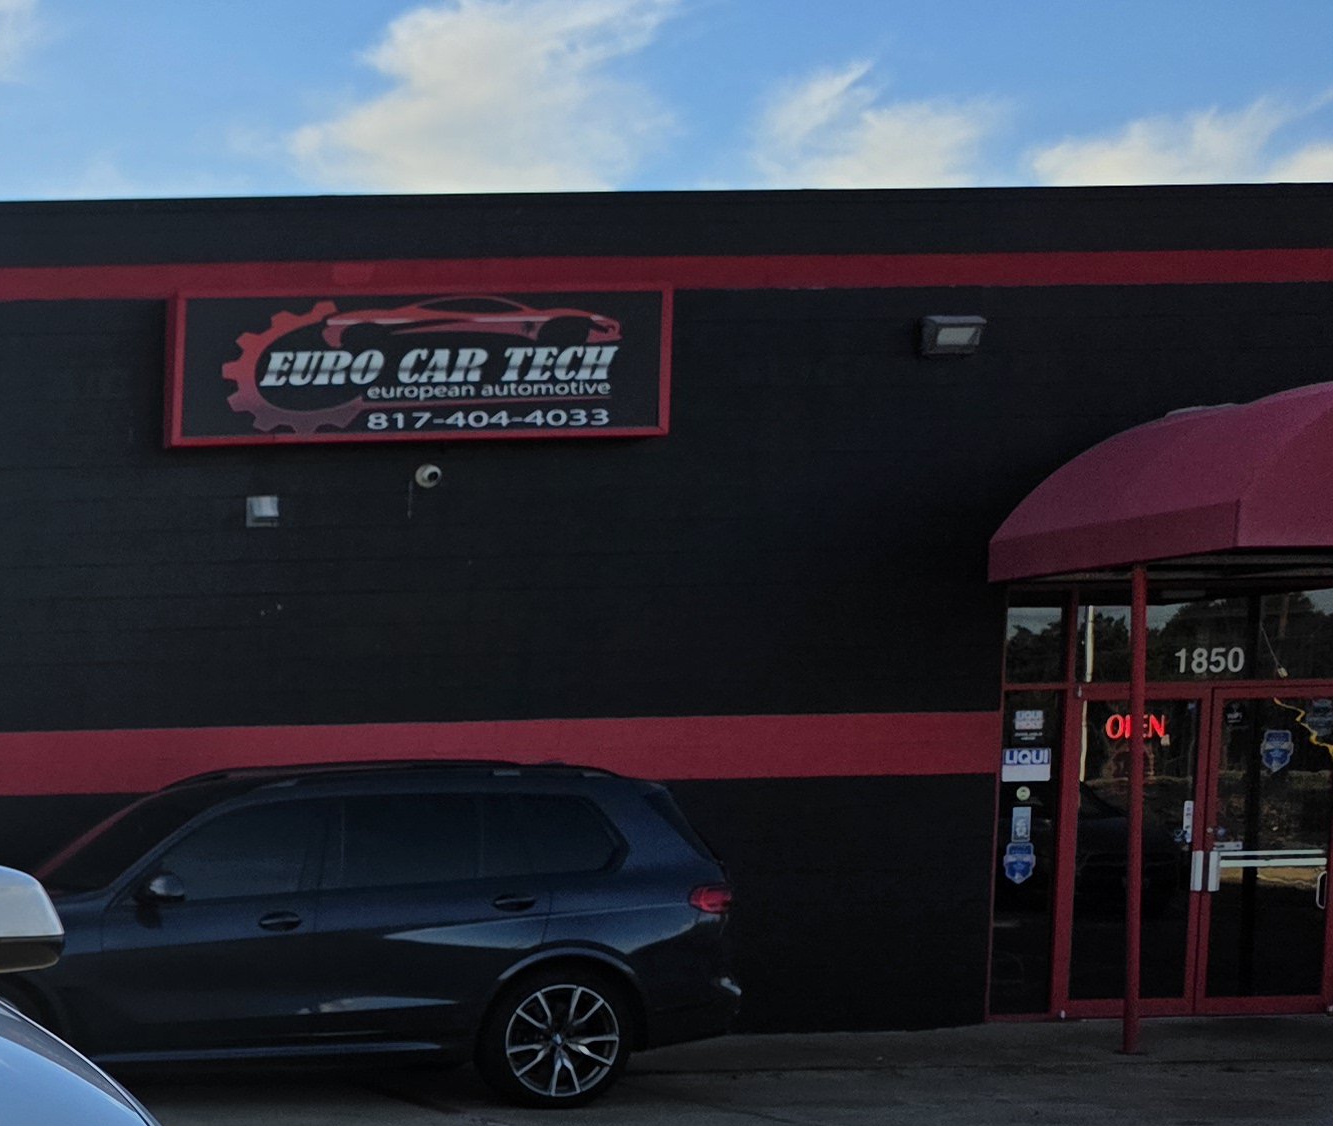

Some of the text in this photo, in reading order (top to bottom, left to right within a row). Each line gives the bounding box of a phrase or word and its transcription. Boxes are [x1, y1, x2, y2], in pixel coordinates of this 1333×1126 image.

[260, 345, 618, 387] EURO CAR TECH
[367, 379, 611, 400] european automotive
[367, 408, 610, 431] 817-404-4033
[1175, 646, 1245, 673] 1850
[1105, 714, 1165, 739] ON
[1005, 749, 1049, 765] LIQUI
